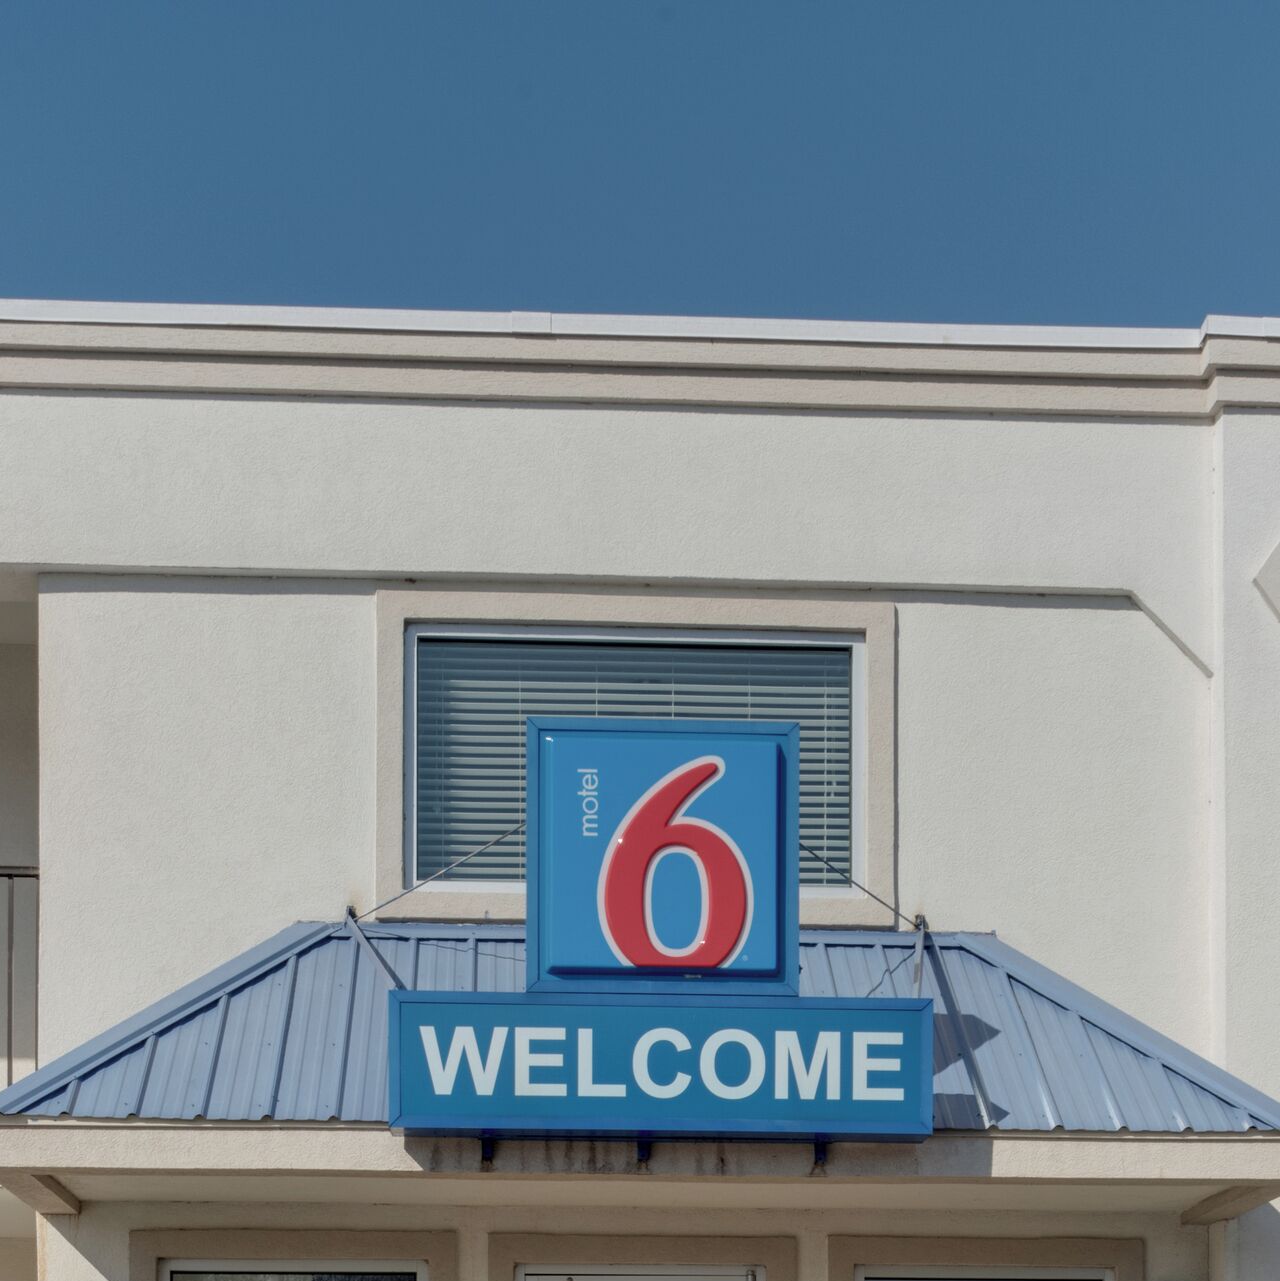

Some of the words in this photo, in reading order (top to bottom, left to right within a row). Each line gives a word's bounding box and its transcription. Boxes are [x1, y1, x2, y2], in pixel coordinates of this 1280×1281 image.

[577, 768, 599, 837] motel
[597, 755, 754, 968] 6
[419, 1025, 905, 1102] WELCOME
